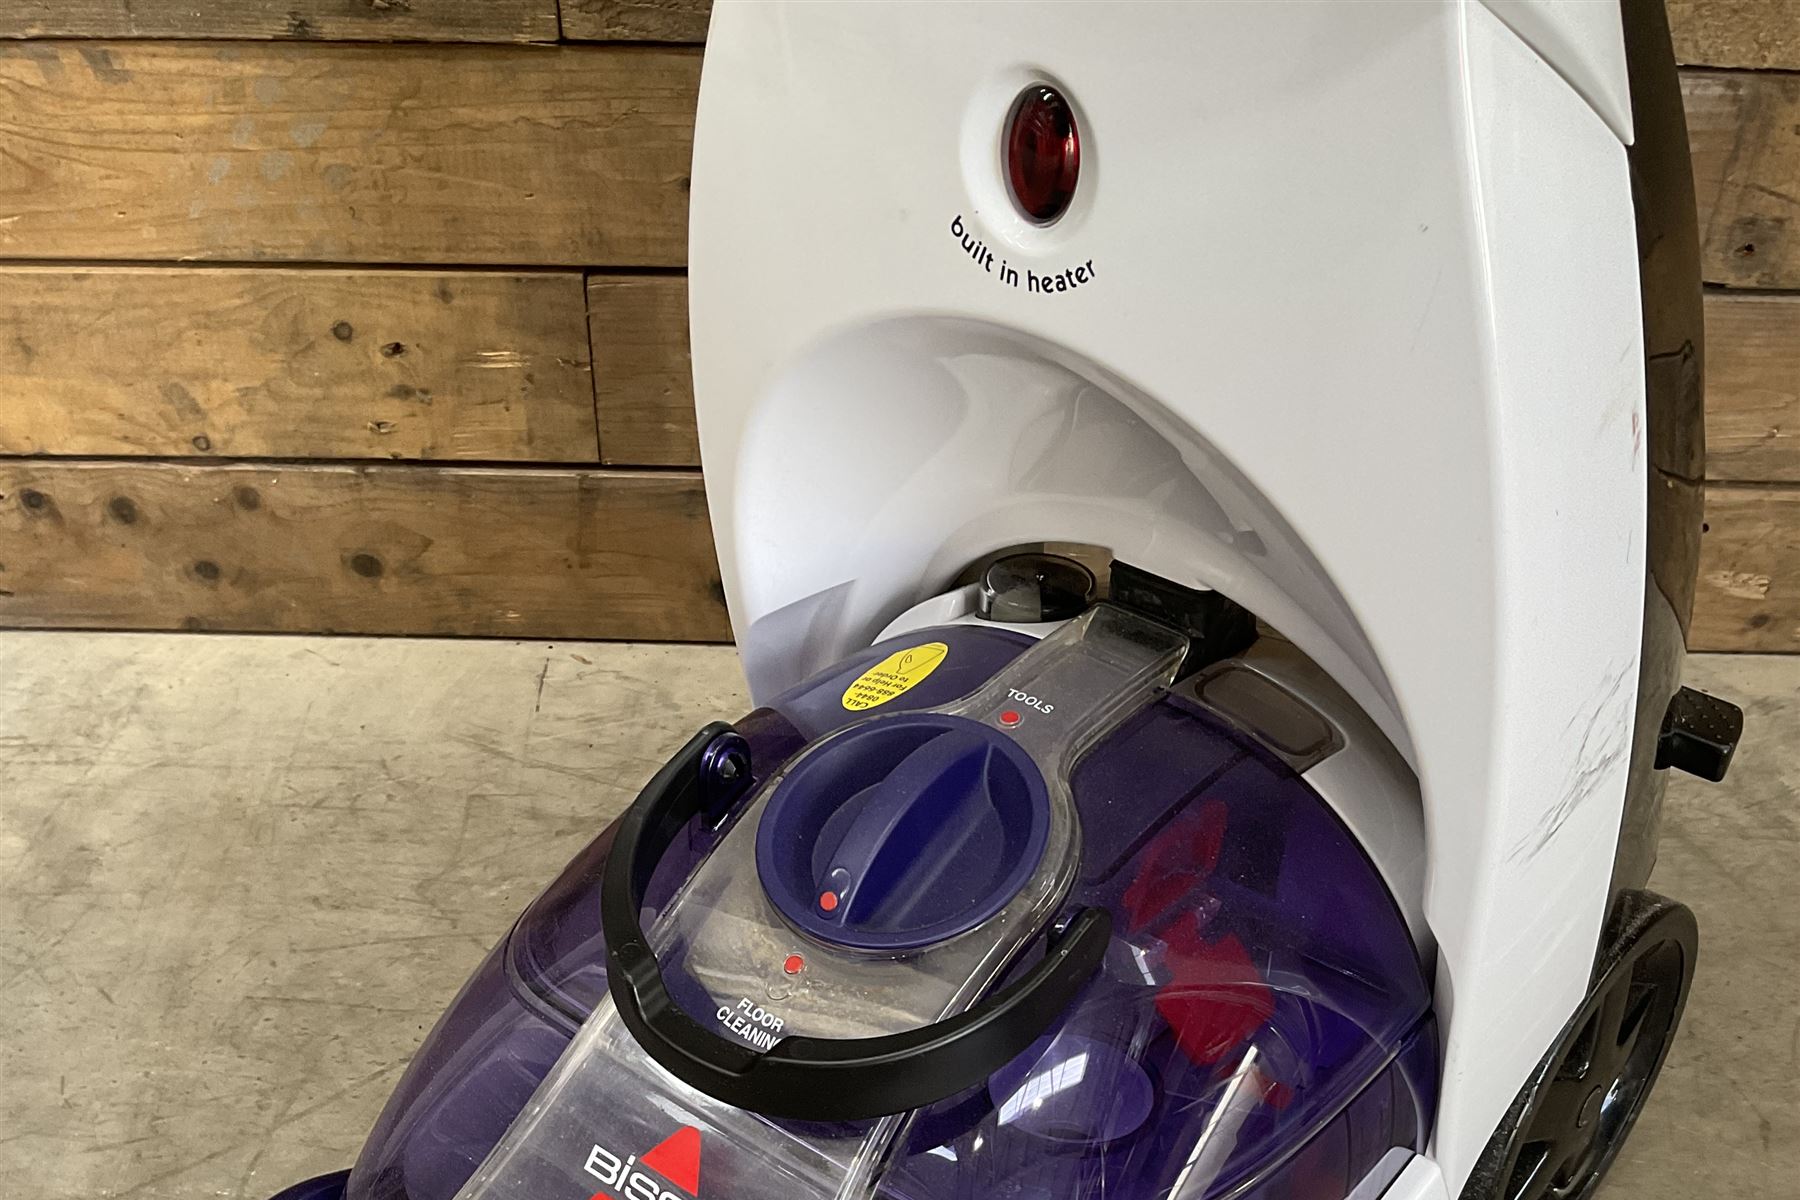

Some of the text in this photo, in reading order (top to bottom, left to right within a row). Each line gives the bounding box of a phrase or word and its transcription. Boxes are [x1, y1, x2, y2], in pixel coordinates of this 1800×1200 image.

[950, 214, 1096, 294] built in heater
[872, 678, 891, 687] Help
[893, 683, 908, 691] For
[846, 697, 869, 709] CALL
[1006, 687, 1055, 715] TOOLS
[736, 997, 785, 1033] FLOOR
